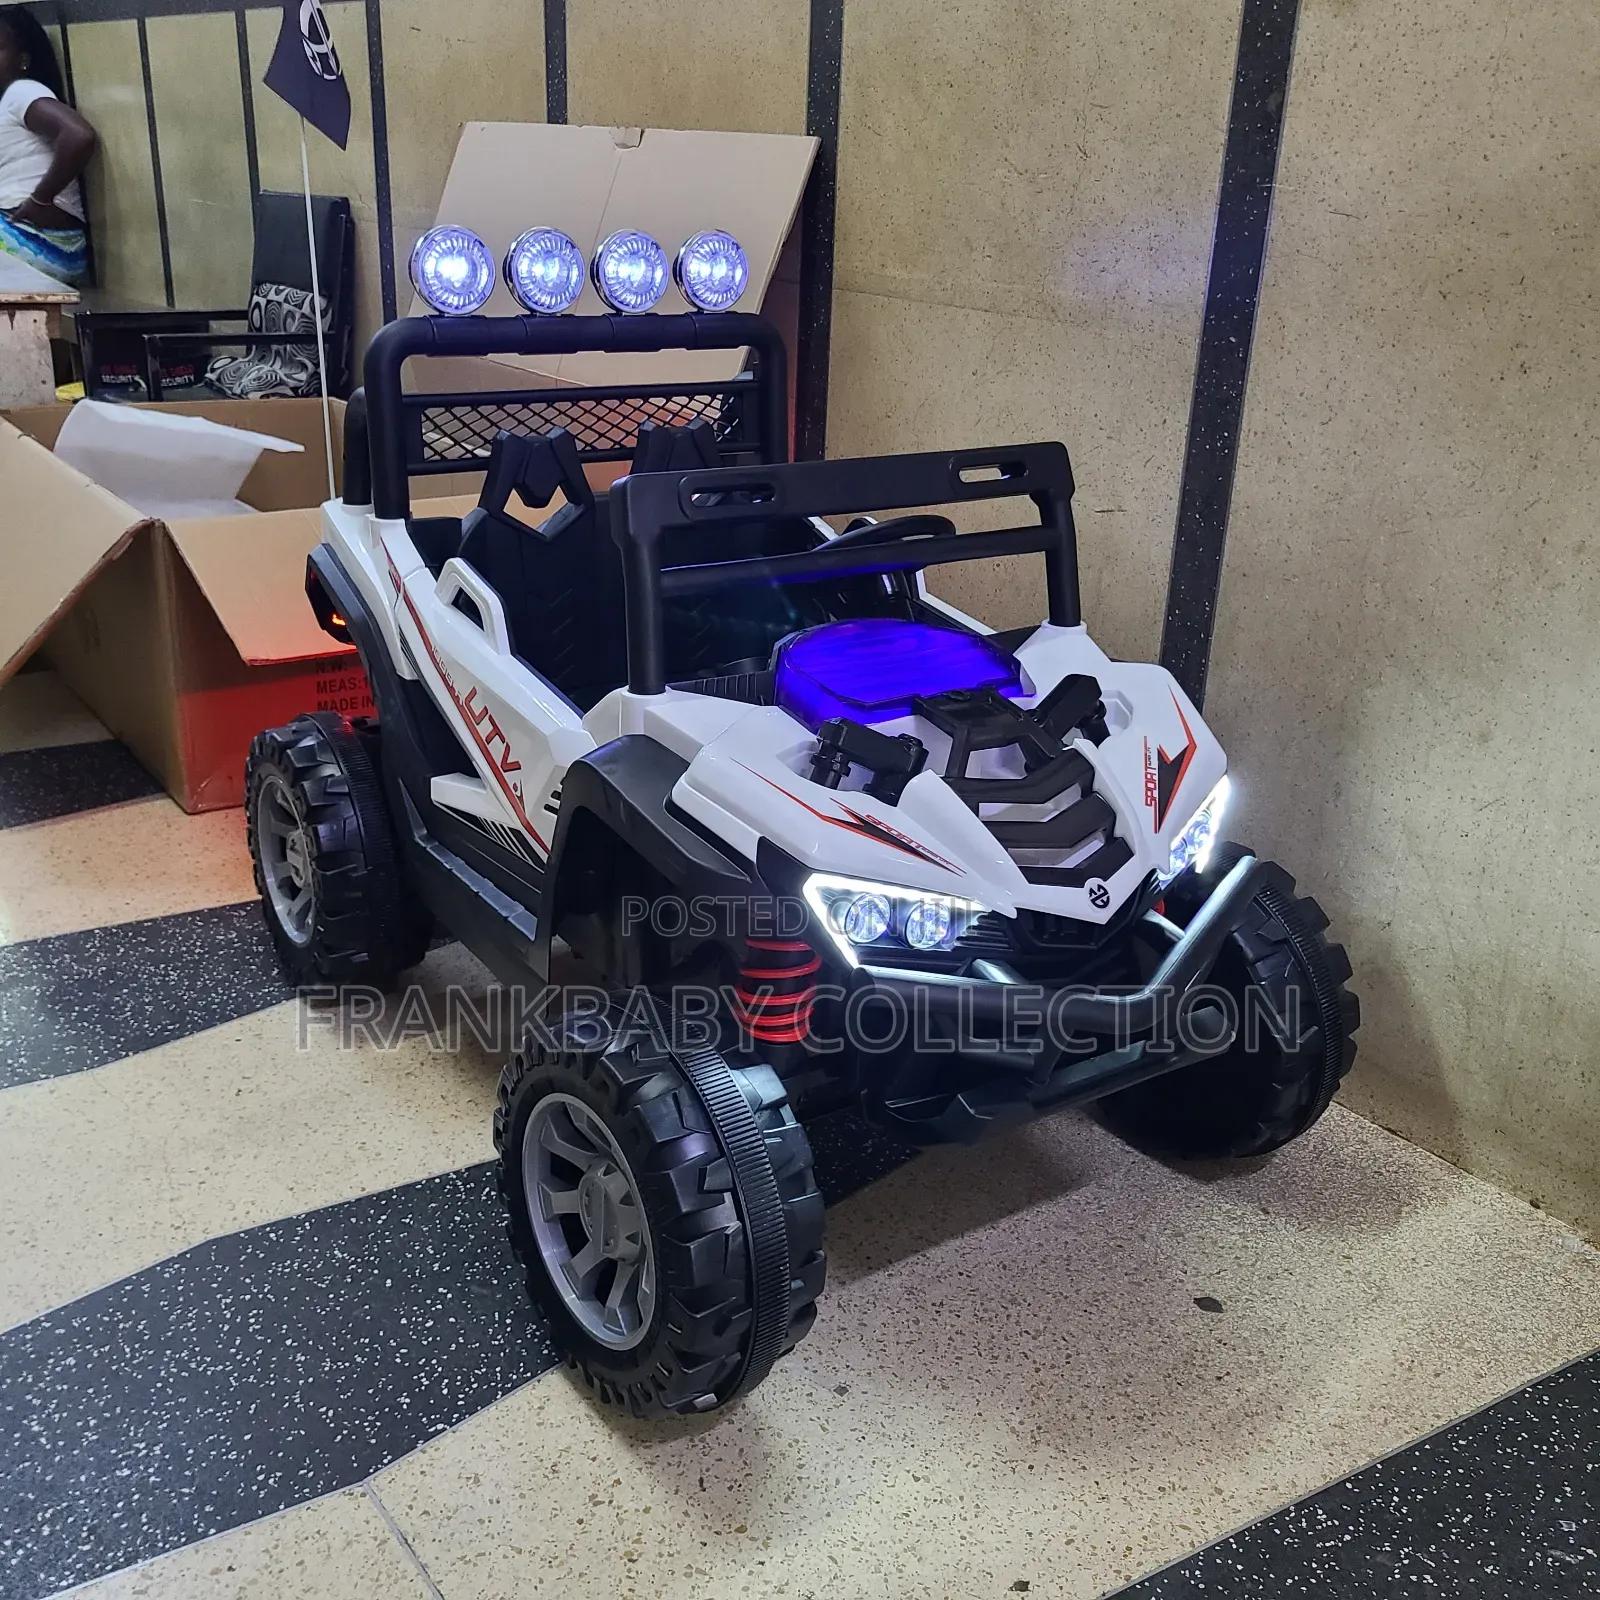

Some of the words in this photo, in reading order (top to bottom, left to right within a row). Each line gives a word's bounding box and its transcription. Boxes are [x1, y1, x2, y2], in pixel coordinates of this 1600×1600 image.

[161, 374, 194, 387] ECURITY
[317, 697, 358, 712] MADE
[362, 696, 375, 708] IN
[464, 686, 522, 773] UTV
[1145, 766, 1157, 806] SPORT
[864, 813, 923, 849] SPORT
